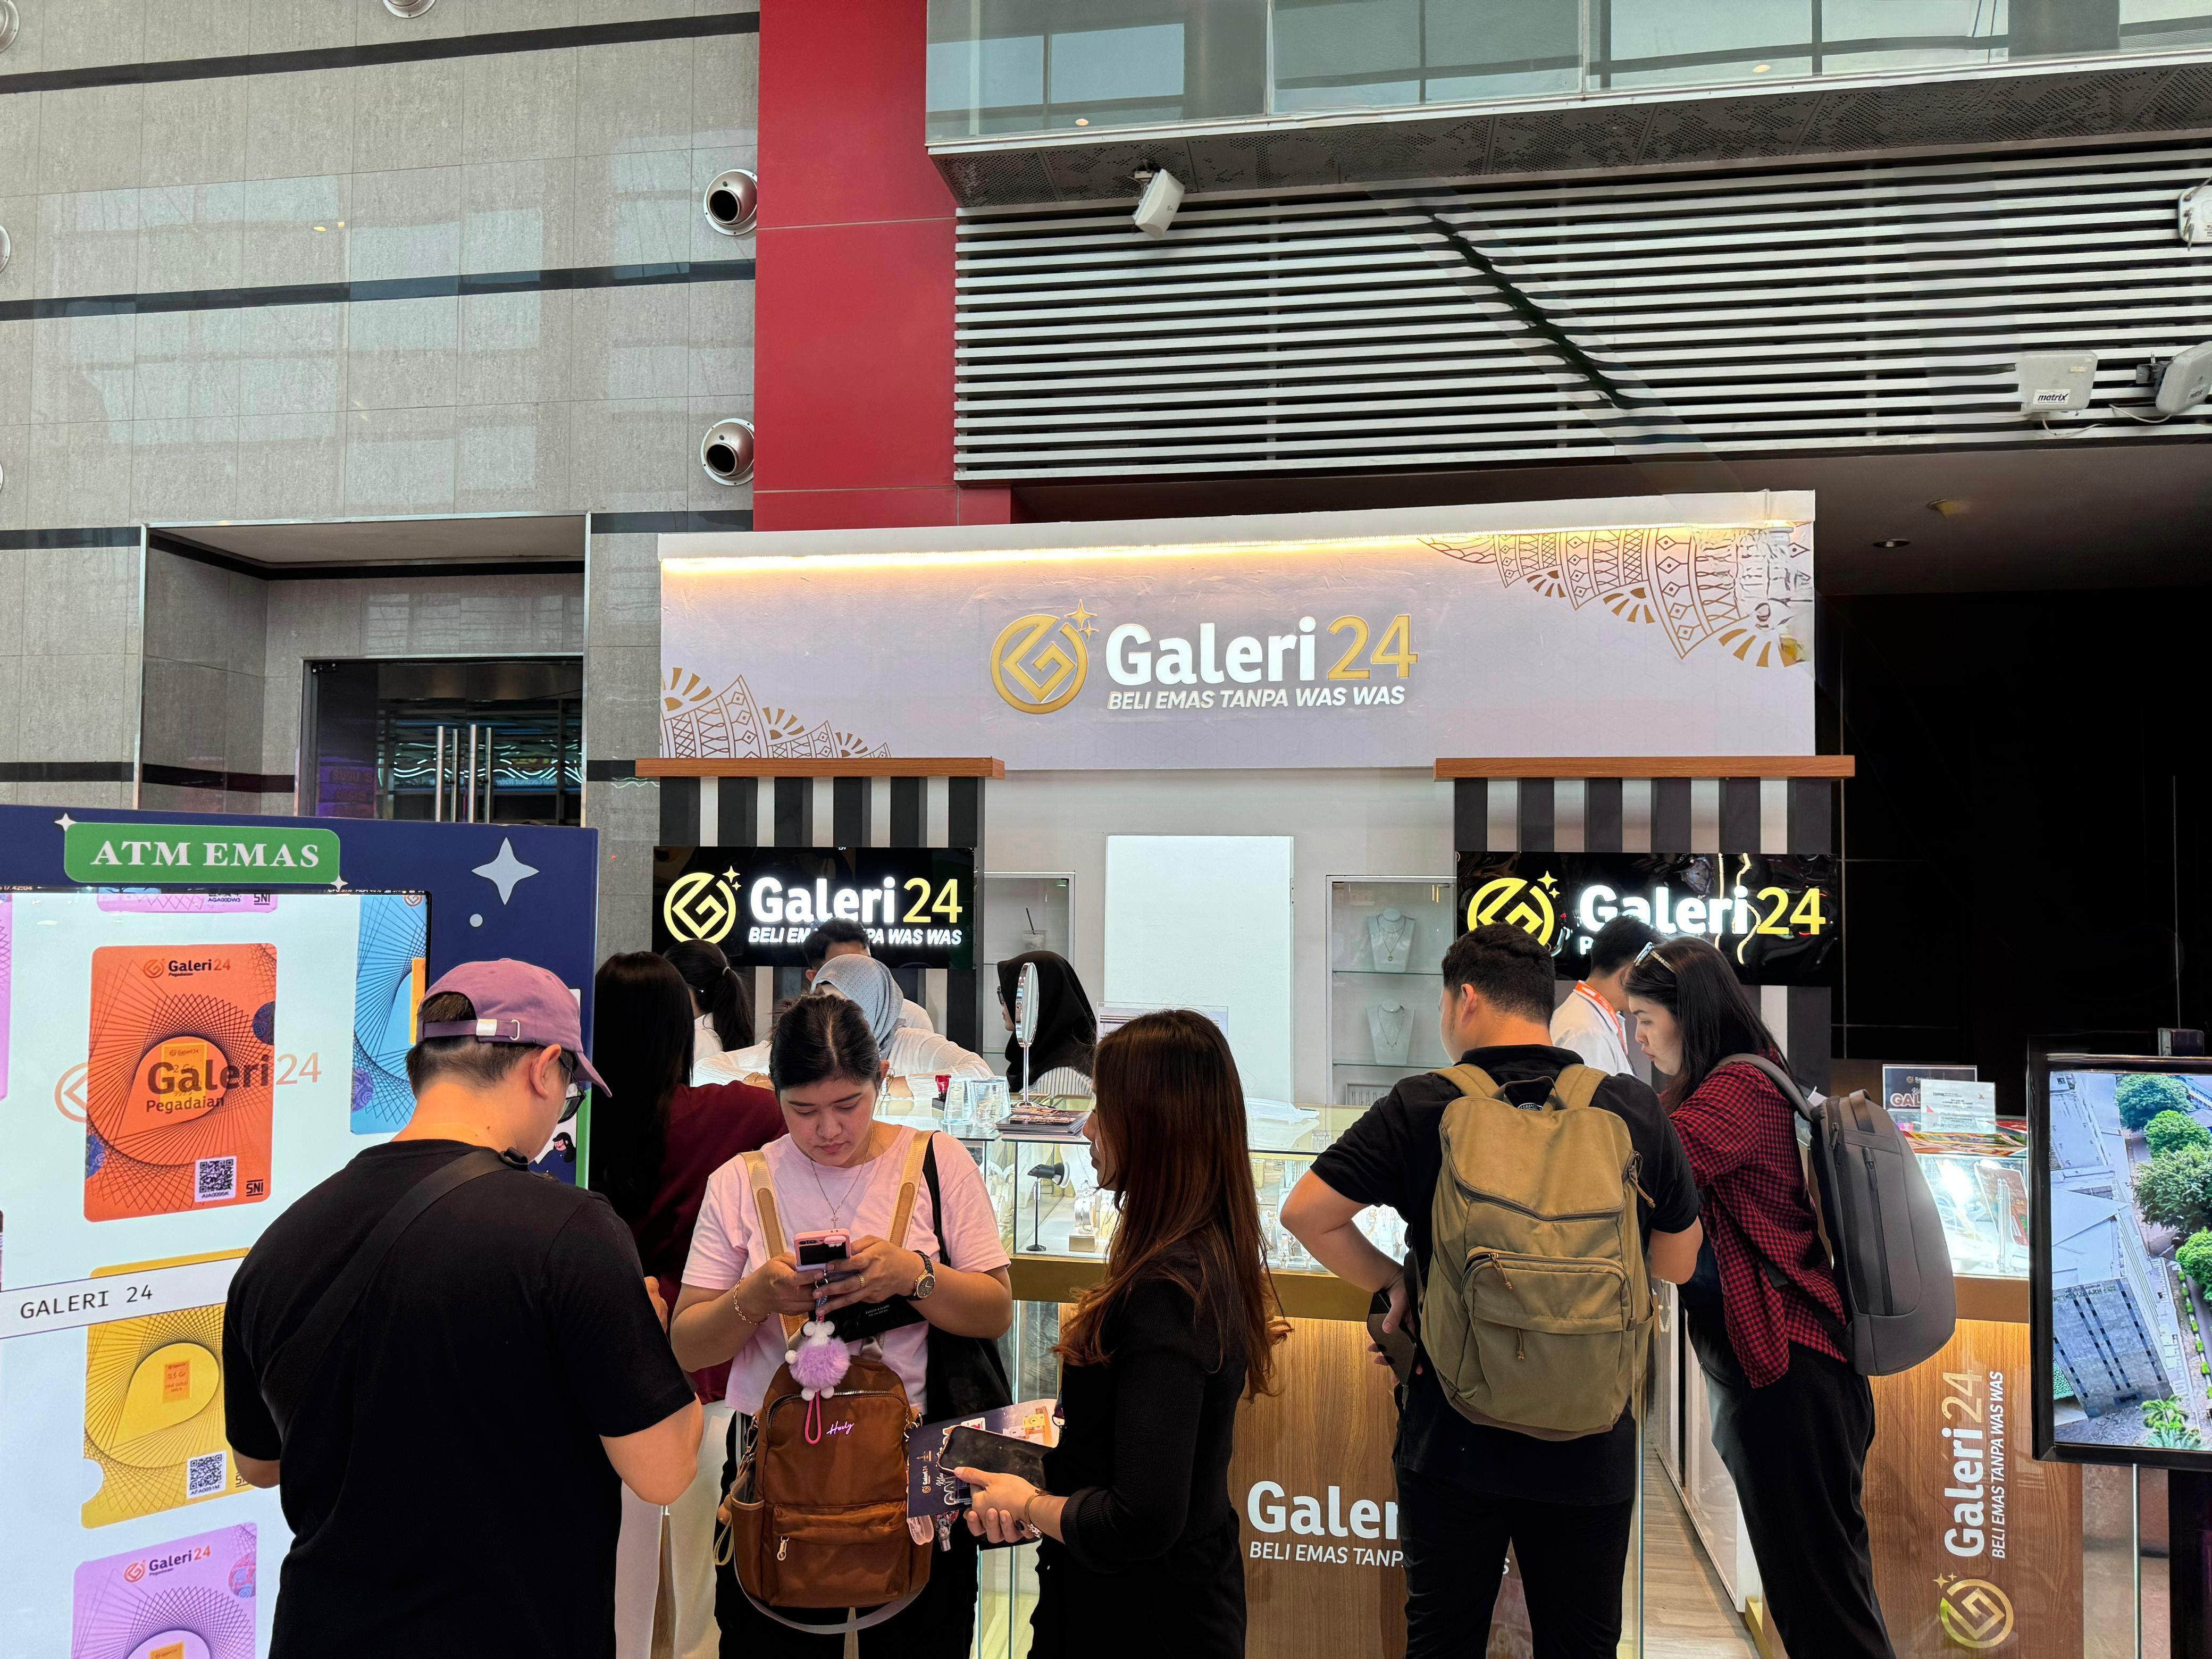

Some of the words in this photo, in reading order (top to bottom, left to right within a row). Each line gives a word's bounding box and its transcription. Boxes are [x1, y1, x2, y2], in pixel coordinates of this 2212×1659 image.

[1105, 616, 1316, 686] Galeri
[1327, 615, 1419, 680] 24
[1107, 691, 1152, 710] BELI
[1154, 690, 1214, 709] EMAS
[1220, 689, 1288, 708] TANPA
[1296, 688, 1347, 706] WAS
[1353, 685, 1405, 706] WAS
[90, 840, 191, 866] ATM
[203, 842, 319, 868] EMAS
[254, 894, 270, 902] SNI
[750, 876, 896, 923] Galeri
[902, 877, 962, 923] 24
[1579, 884, 1748, 935] Galeri
[1756, 886, 1826, 935] 24
[748, 927, 785, 943] BELI
[786, 927, 811, 943] EM
[888, 928, 924, 944] WAS
[927, 929, 962, 945] WAS
[168, 959, 212, 971] Galeri
[213, 958, 231, 971] 24
[147, 1054, 269, 1094] Galeri
[275, 1052, 322, 1085] 24
[146, 1096, 225, 1115] Pegadaian
[246, 1182, 263, 1194] SNI
[20, 1290, 110, 1319] GALERI
[126, 1284, 153, 1303] 24
[1941, 1369, 1983, 1423] 24
[1989, 1371, 2004, 1402] WAS
[1990, 1404, 2004, 1435] WAS
[1990, 1438, 2005, 1482] TANPA
[1942, 1427, 1984, 1557] Galeri
[1991, 1485, 2005, 1526] EMAS
[1247, 1480, 1399, 1540] Galer
[149, 1549, 191, 1571] Galeri
[194, 1545, 211, 1561] 24
[1250, 1541, 1291, 1561] BELI
[1295, 1544, 1348, 1564] EMAS
[1353, 1547, 1405, 1568] TANP
[1991, 1528, 2005, 1559] BELI
